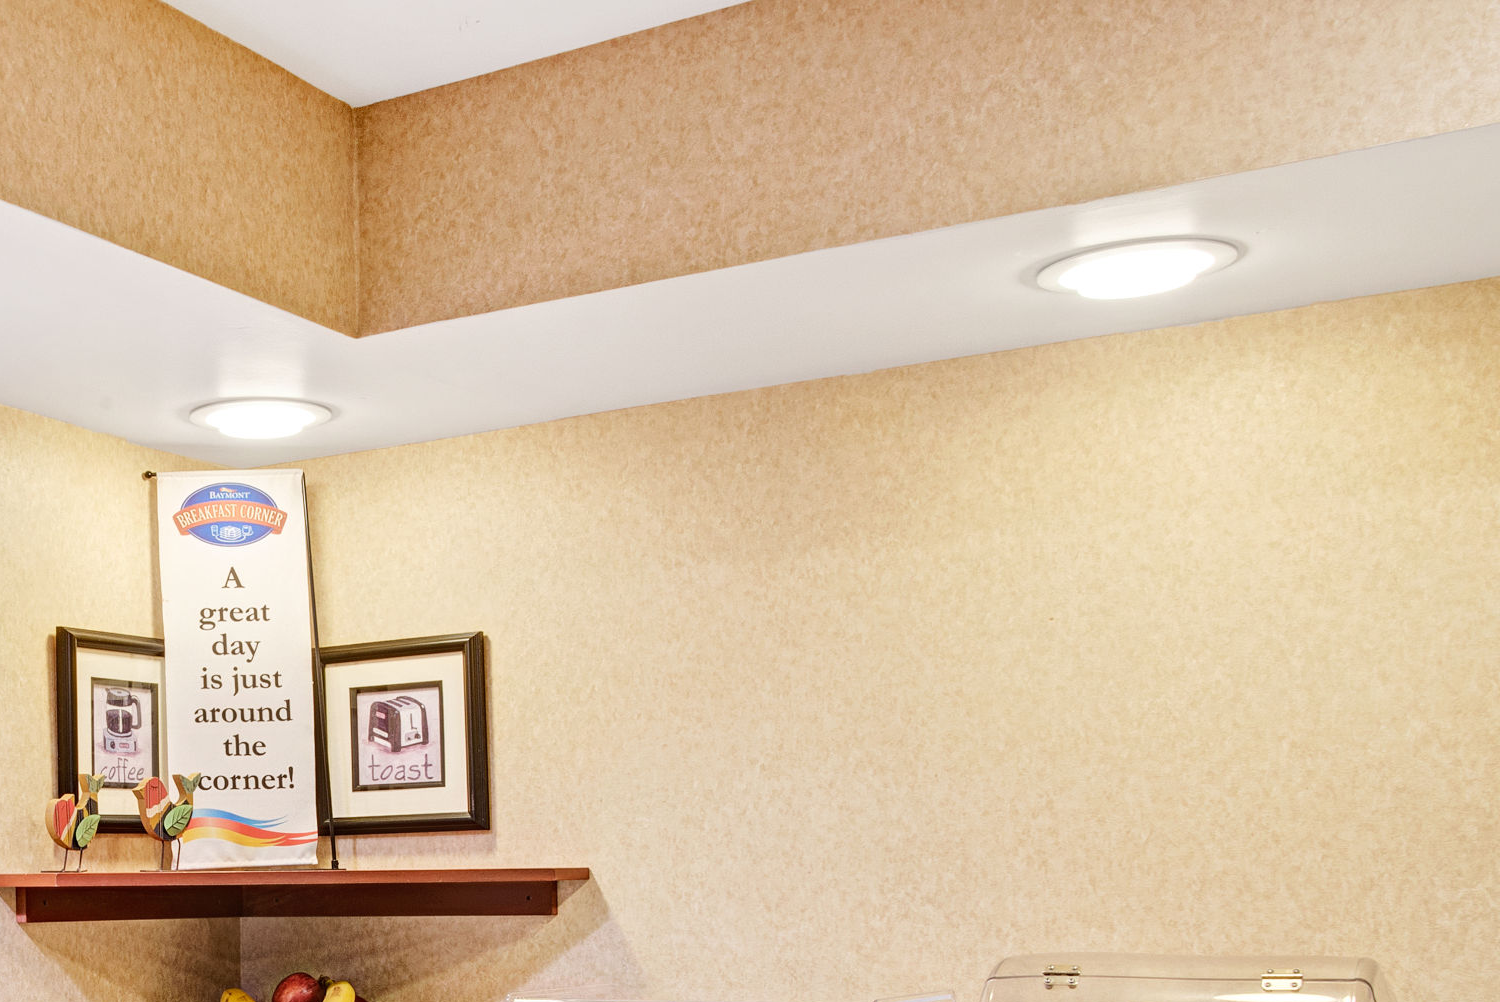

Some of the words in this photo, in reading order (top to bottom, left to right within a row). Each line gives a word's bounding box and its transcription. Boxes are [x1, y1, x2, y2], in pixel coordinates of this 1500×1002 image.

[209, 490, 250, 500] BAYMONT
[176, 503, 238, 529] BREAKFAST
[240, 503, 284, 529] CORNER
[221, 566, 245, 589] A
[199, 604, 271, 631] great
[212, 633, 261, 663] day
[201, 667, 223, 690] is
[233, 666, 283, 697] just
[194, 700, 293, 723] around
[223, 734, 267, 757] the
[100, 757, 145, 783] coffee
[199, 766, 295, 791] corner!
[368, 753, 434, 781] toast
